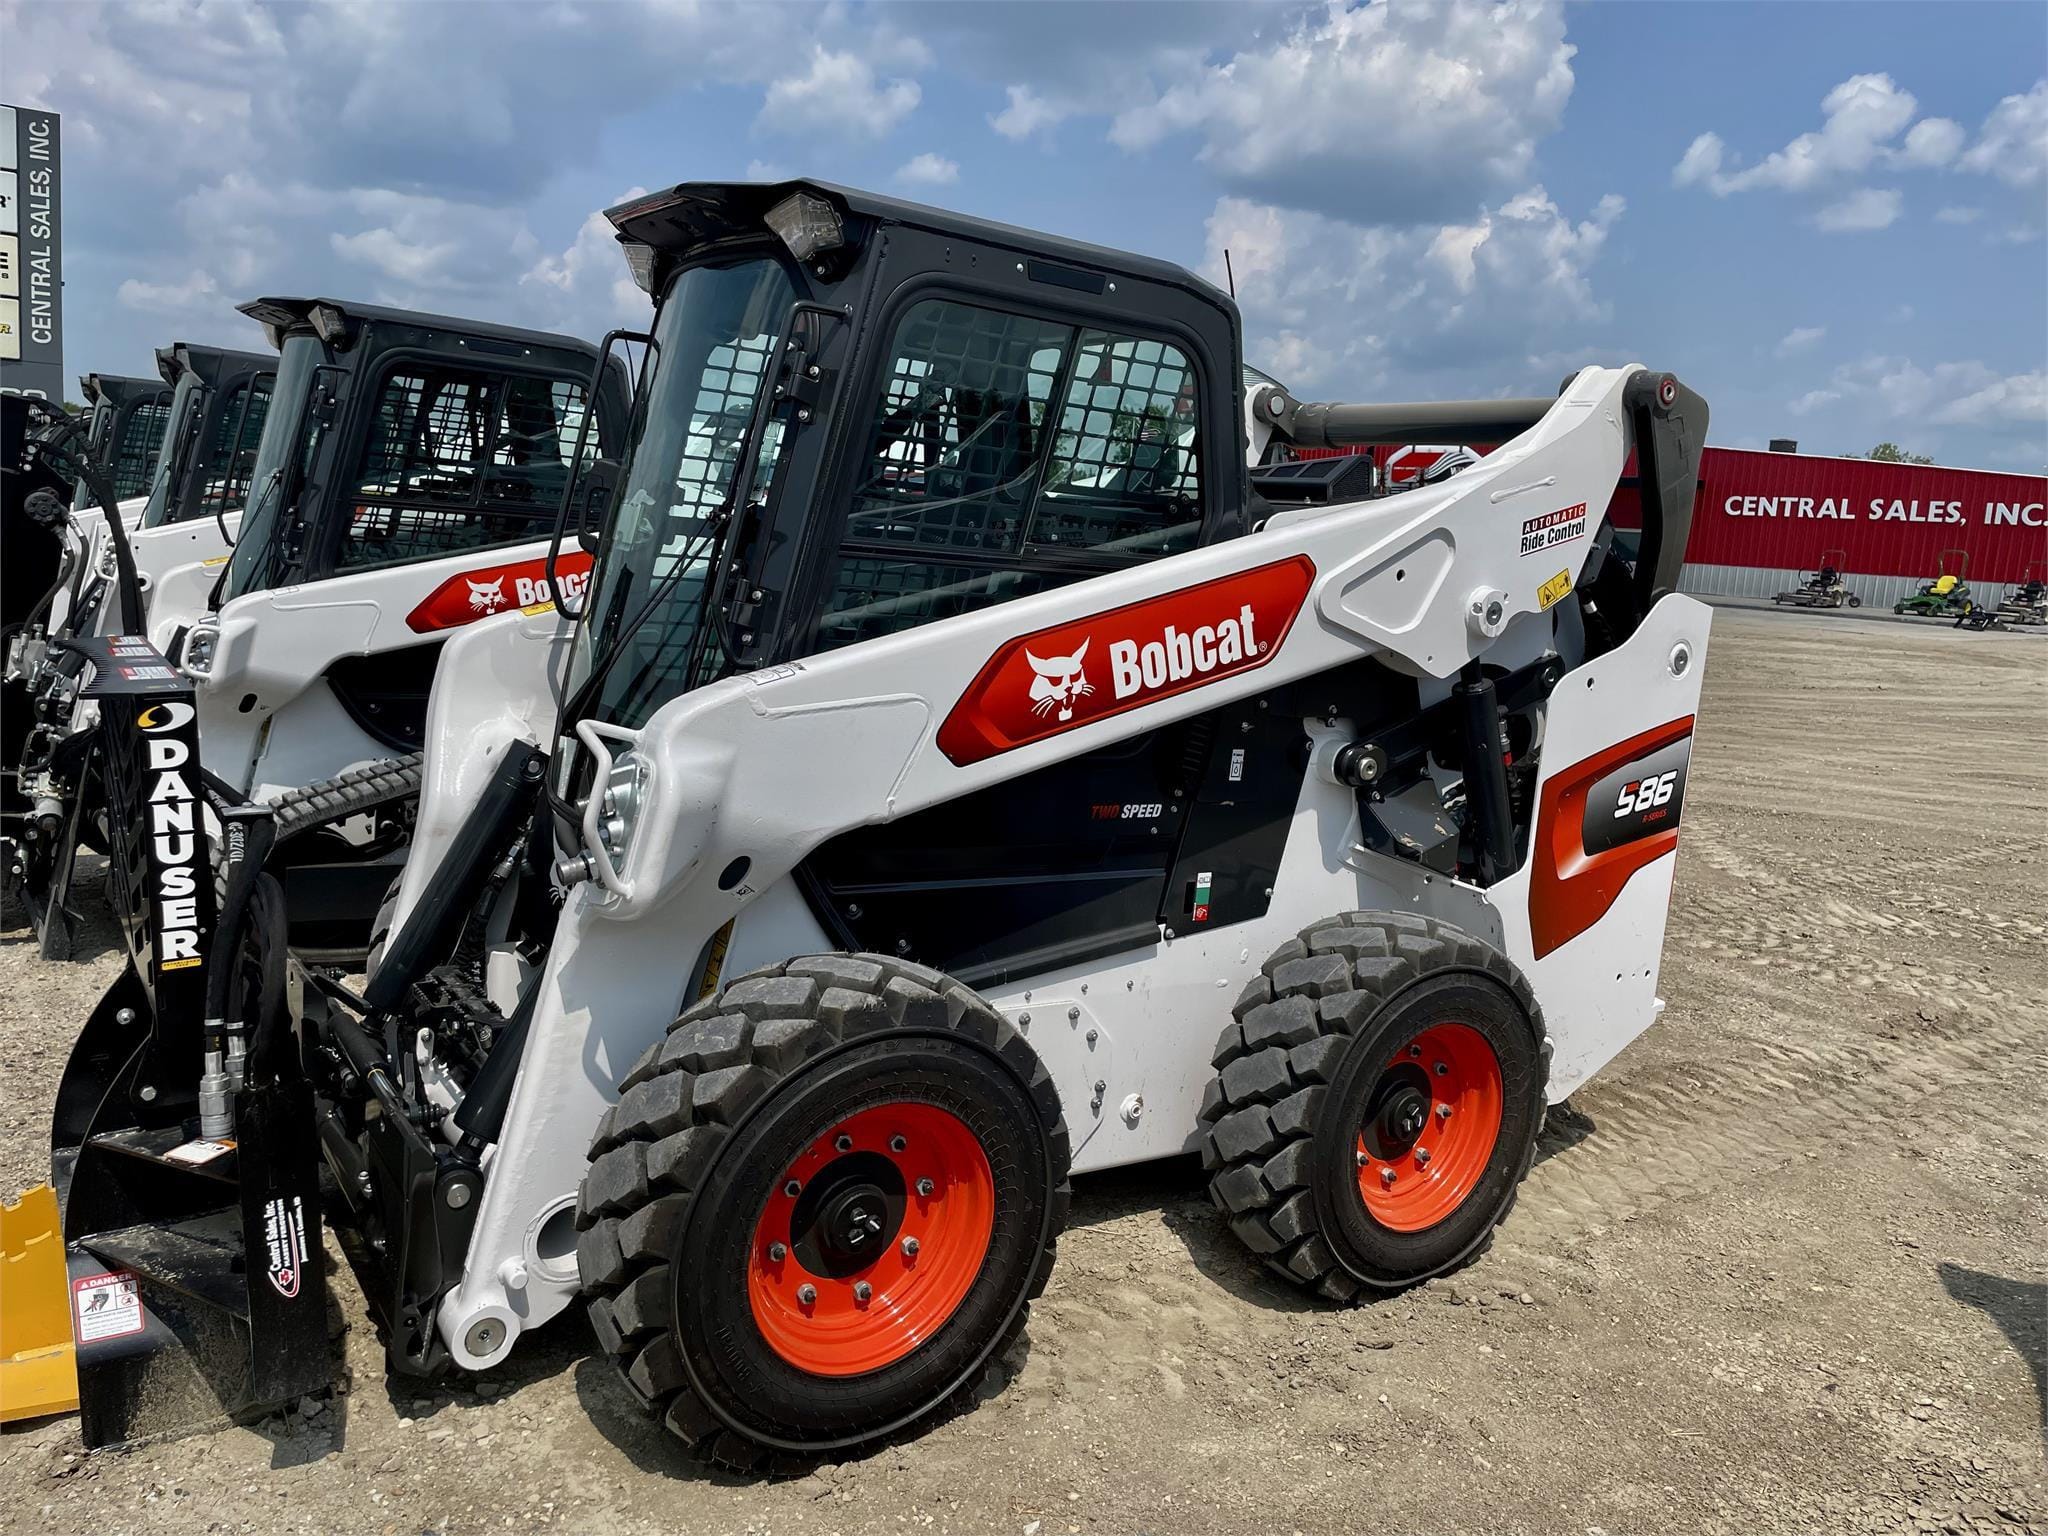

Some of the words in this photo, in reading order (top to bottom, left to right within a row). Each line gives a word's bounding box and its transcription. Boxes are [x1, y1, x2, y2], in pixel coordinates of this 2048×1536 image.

[28, 119, 50, 161] INC.
[29, 167, 53, 240] SALES,
[31, 245, 52, 344] CENTRAL
[1523, 504, 1586, 534] AUTOMATIC
[1724, 495, 1856, 520] CENTRAL
[1868, 498, 1968, 527] SALES,
[1984, 502, 2048, 527] INC.
[1520, 531, 1545, 555] Ride
[1547, 517, 1586, 546] Control
[1109, 604, 1258, 700] Bobcat
[1091, 804, 1120, 819] TWO
[1121, 803, 1163, 819] SPEED
[1614, 770, 1678, 819] S86
[148, 738, 202, 961] DANUSER
[264, 1200, 276, 1218] Inc.
[277, 1198, 288, 1238] FERGUSON
[266, 1216, 280, 1241] Sales,
[269, 1240, 283, 1272] Central
[89, 1273, 132, 1286] DANGER
